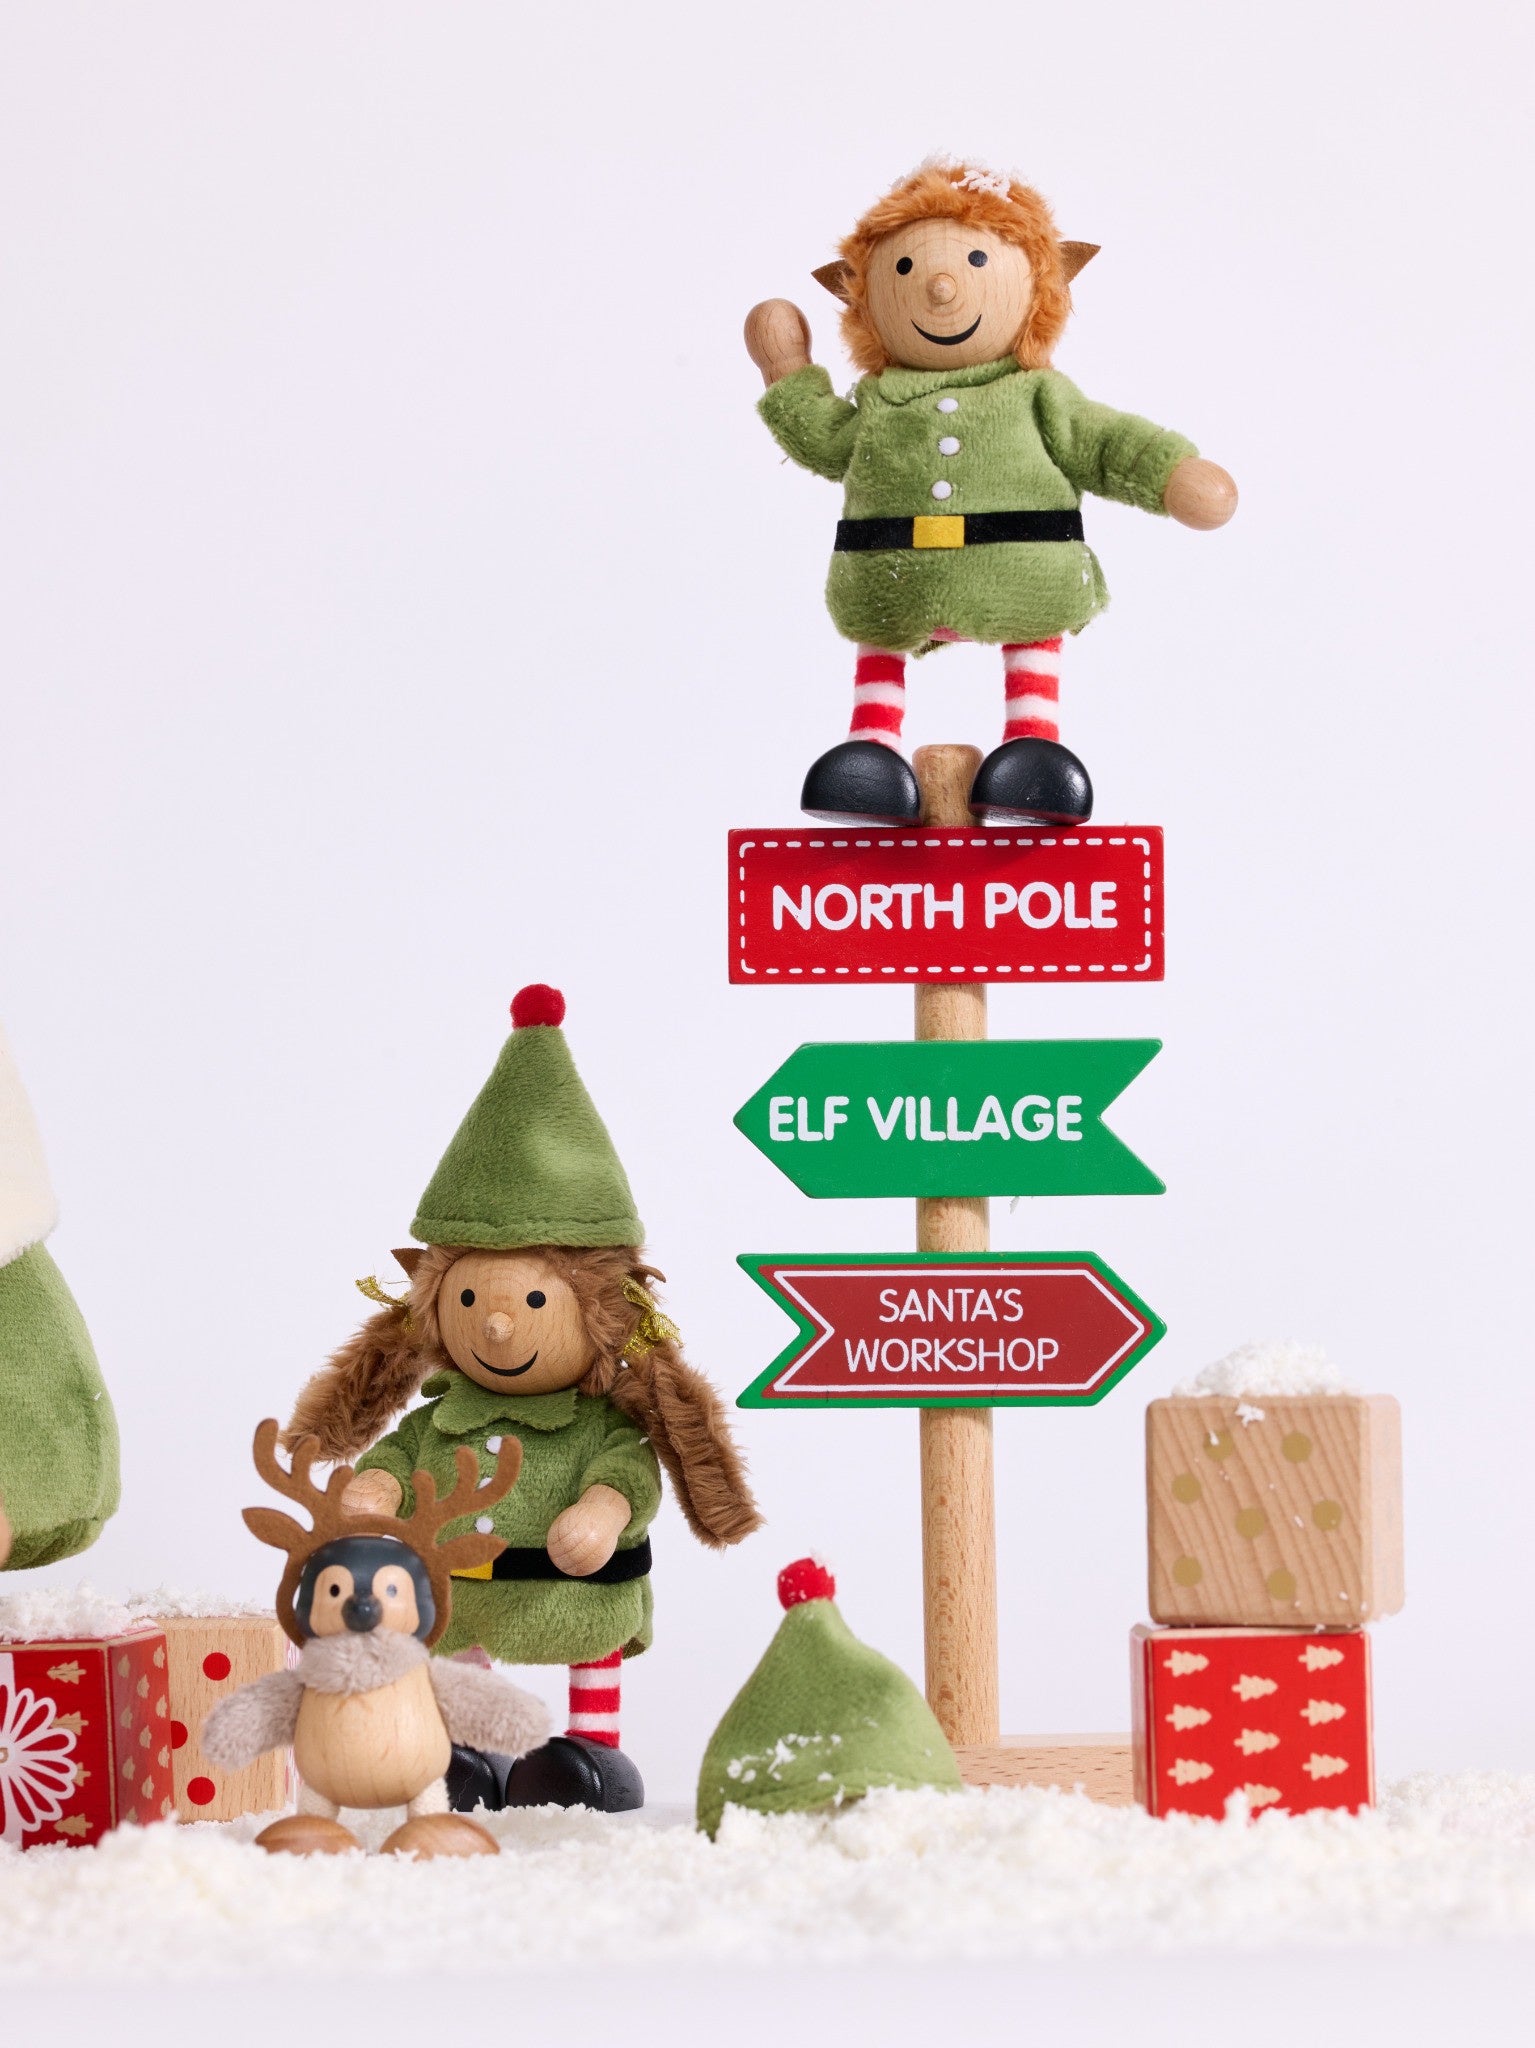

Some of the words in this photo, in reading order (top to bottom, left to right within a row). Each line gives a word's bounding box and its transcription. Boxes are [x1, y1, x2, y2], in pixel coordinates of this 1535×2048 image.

[771, 882, 965, 931] NORTH
[984, 880, 1119, 930] POLE
[768, 1094, 850, 1142] ELF
[866, 1094, 1084, 1142] VILLAGE
[878, 1287, 1024, 1323] SANTA'S
[843, 1336, 1060, 1373] WORKSHOP
